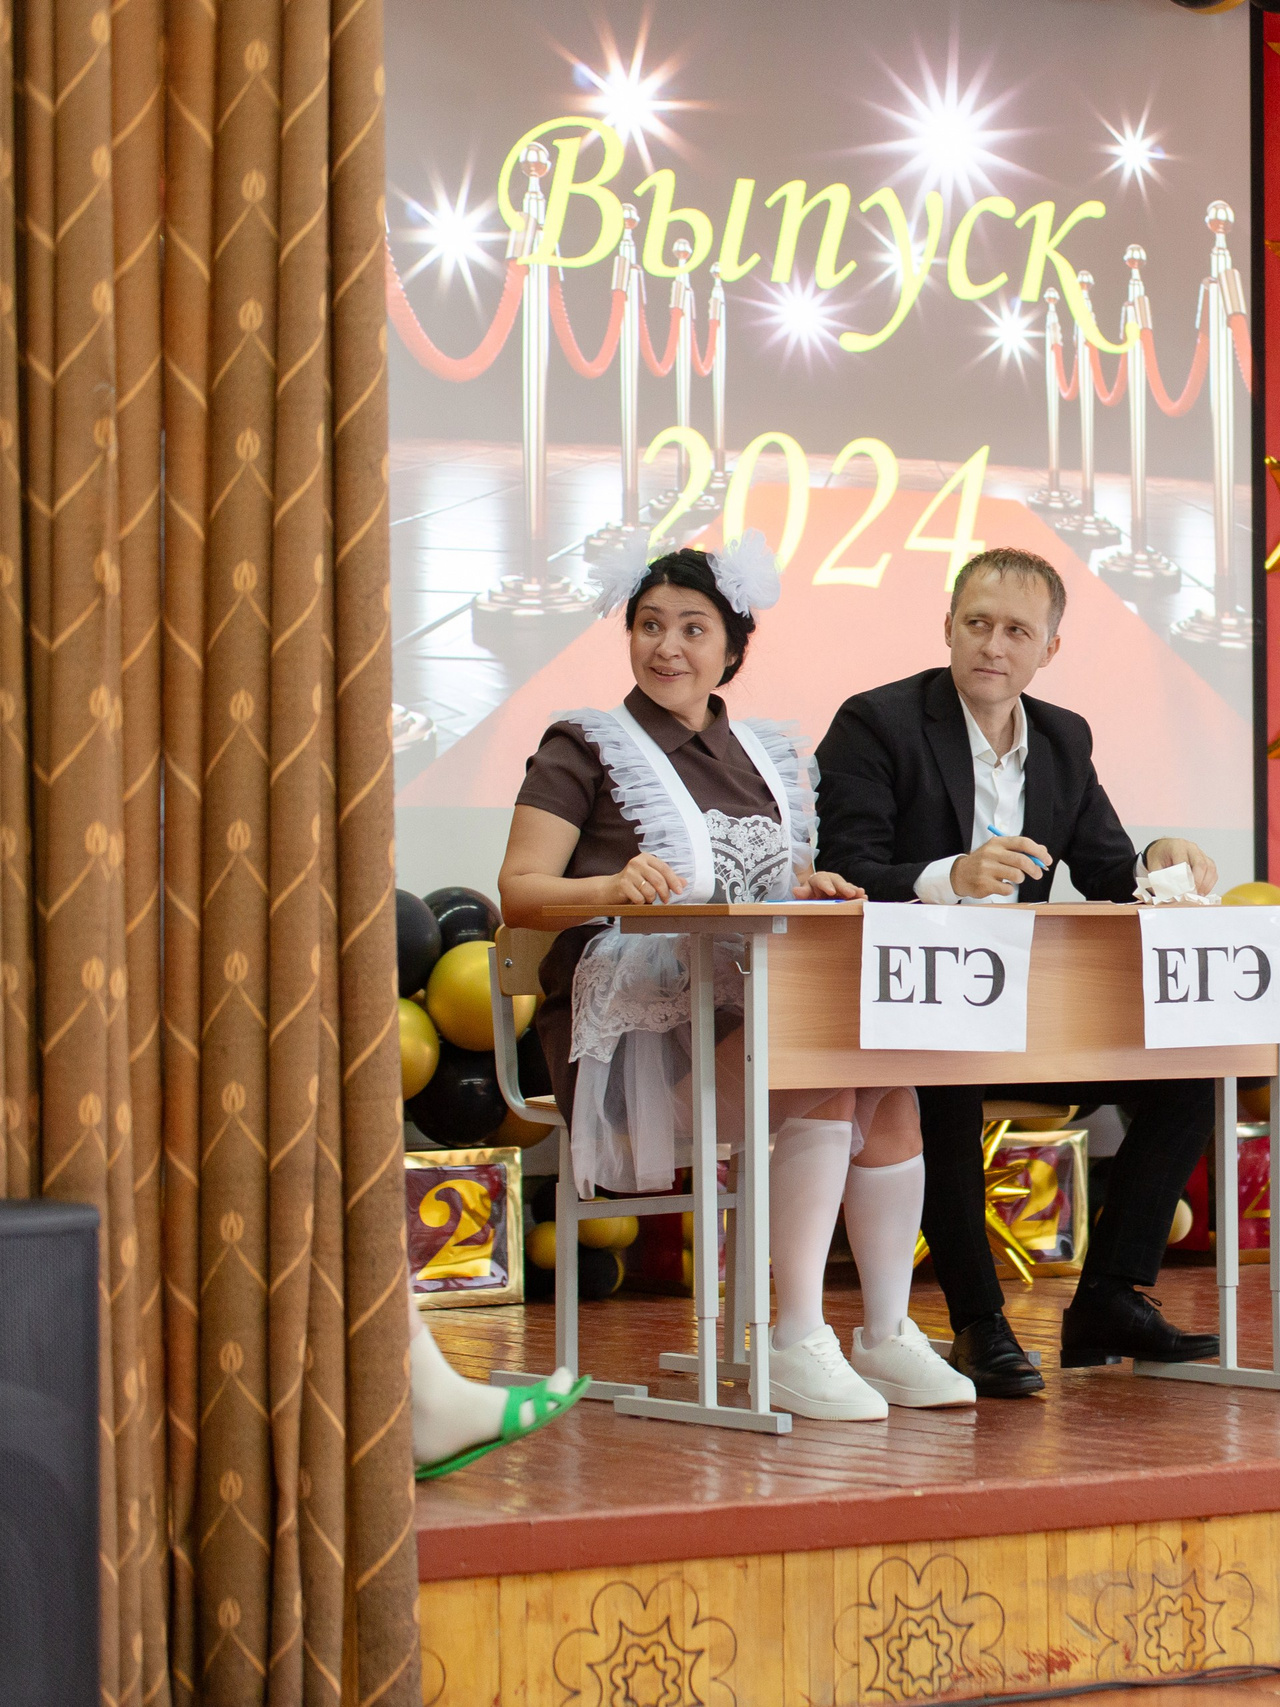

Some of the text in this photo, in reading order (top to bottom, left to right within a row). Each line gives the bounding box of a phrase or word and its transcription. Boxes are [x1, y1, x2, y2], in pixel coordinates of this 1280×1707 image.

[497, 115, 1141, 353] Выпуск
[643, 425, 990, 593] 2024
[872, 944, 1006, 1007] ЕГЭ
[1151, 944, 1272, 1005] ЕГЭ
[416, 1178, 495, 1280] 2
